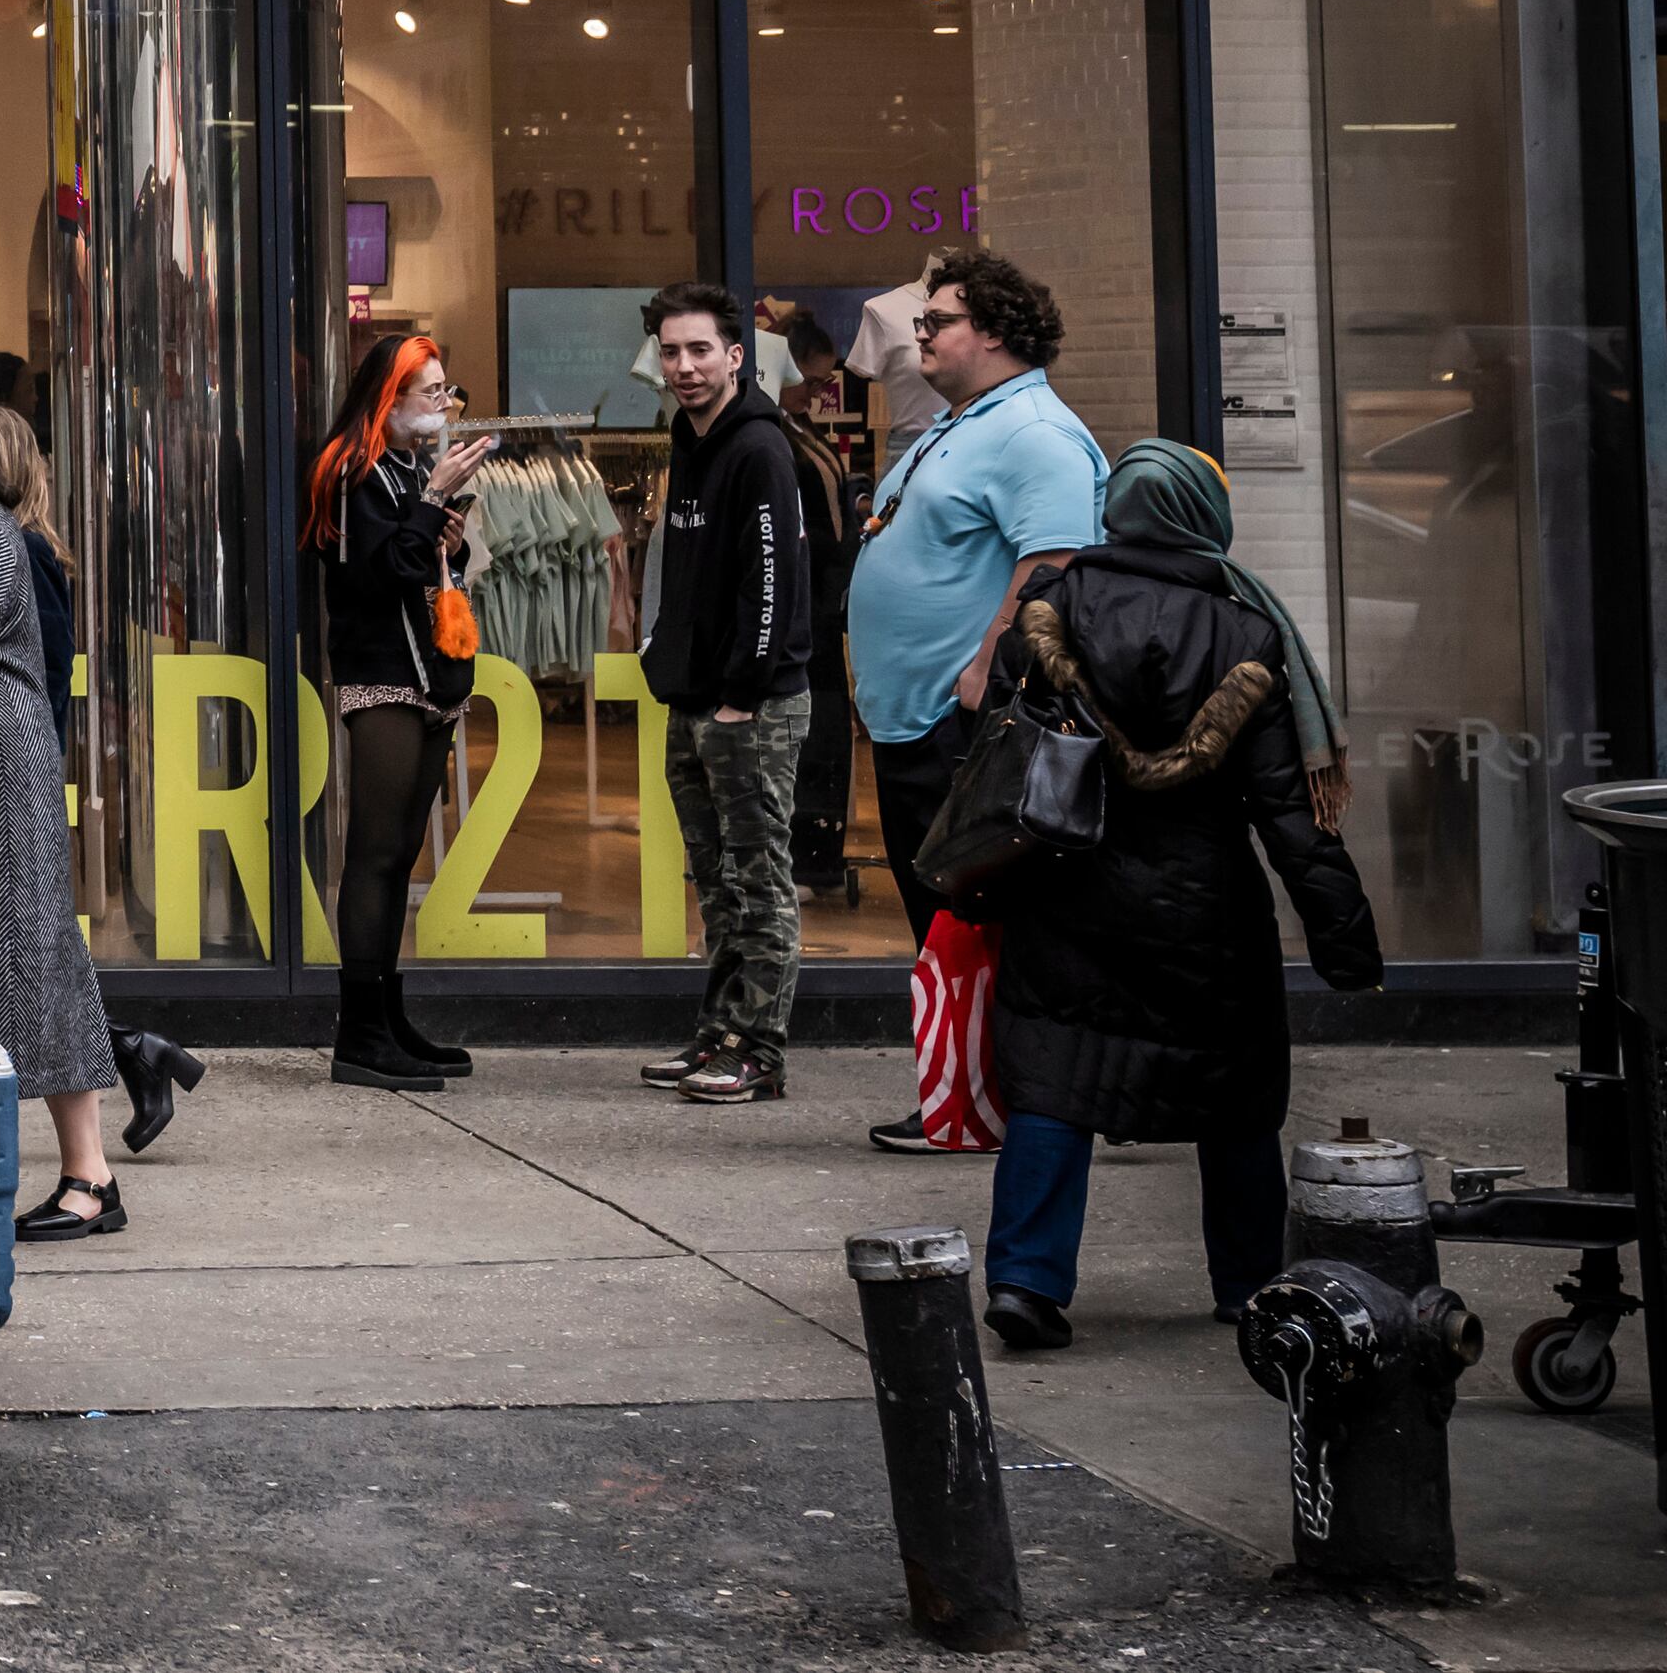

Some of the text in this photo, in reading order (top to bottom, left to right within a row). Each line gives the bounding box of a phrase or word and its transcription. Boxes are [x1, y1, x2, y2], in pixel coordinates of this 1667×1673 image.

[755, 503, 776, 658] I GOT A STORY TO TELL
